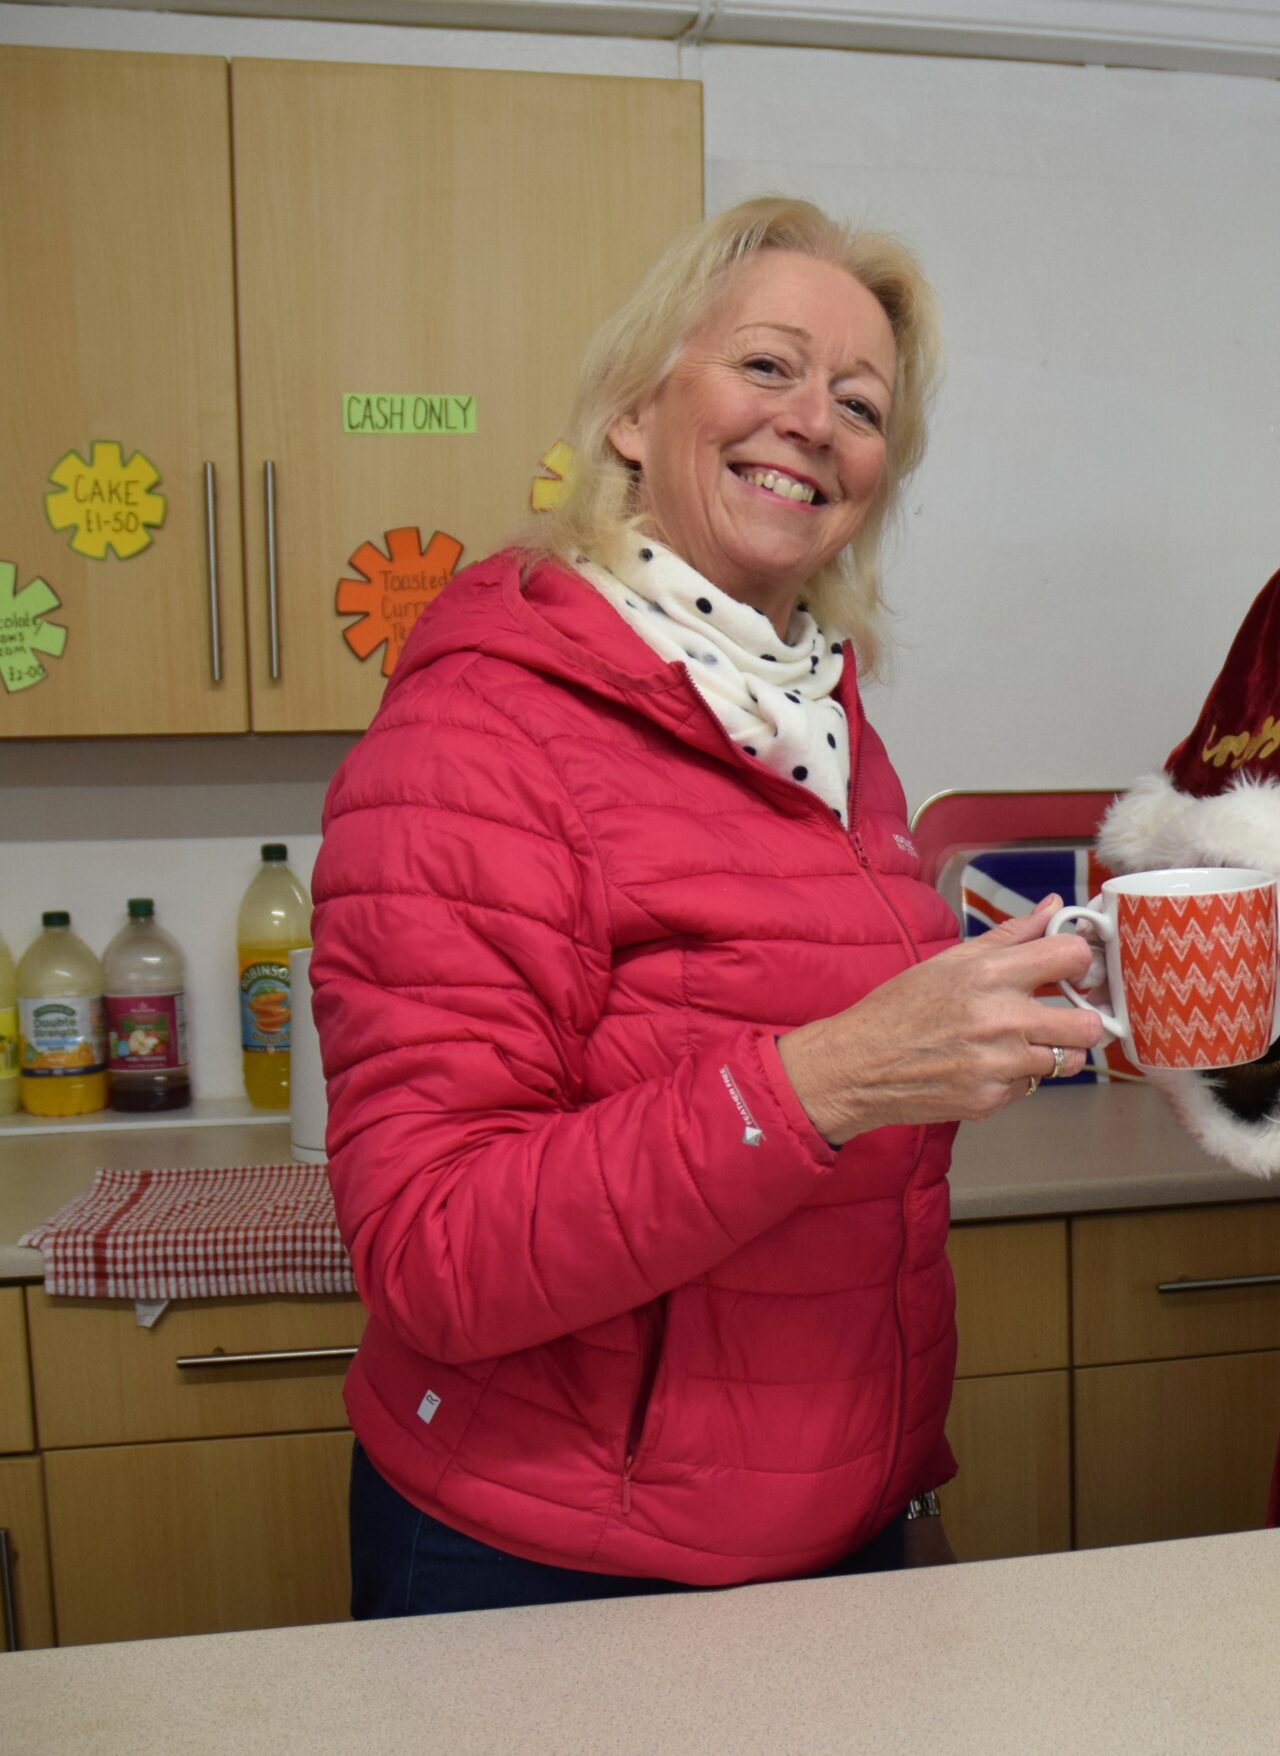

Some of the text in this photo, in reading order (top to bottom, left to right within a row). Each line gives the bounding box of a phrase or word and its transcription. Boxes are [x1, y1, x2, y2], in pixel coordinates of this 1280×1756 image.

[347, 395, 473, 430] CASH ONLY
[74, 474, 139, 506] CAKE
[379, 568, 448, 592] Toasted
[720, 1067, 752, 1125] FEATHER FREE
